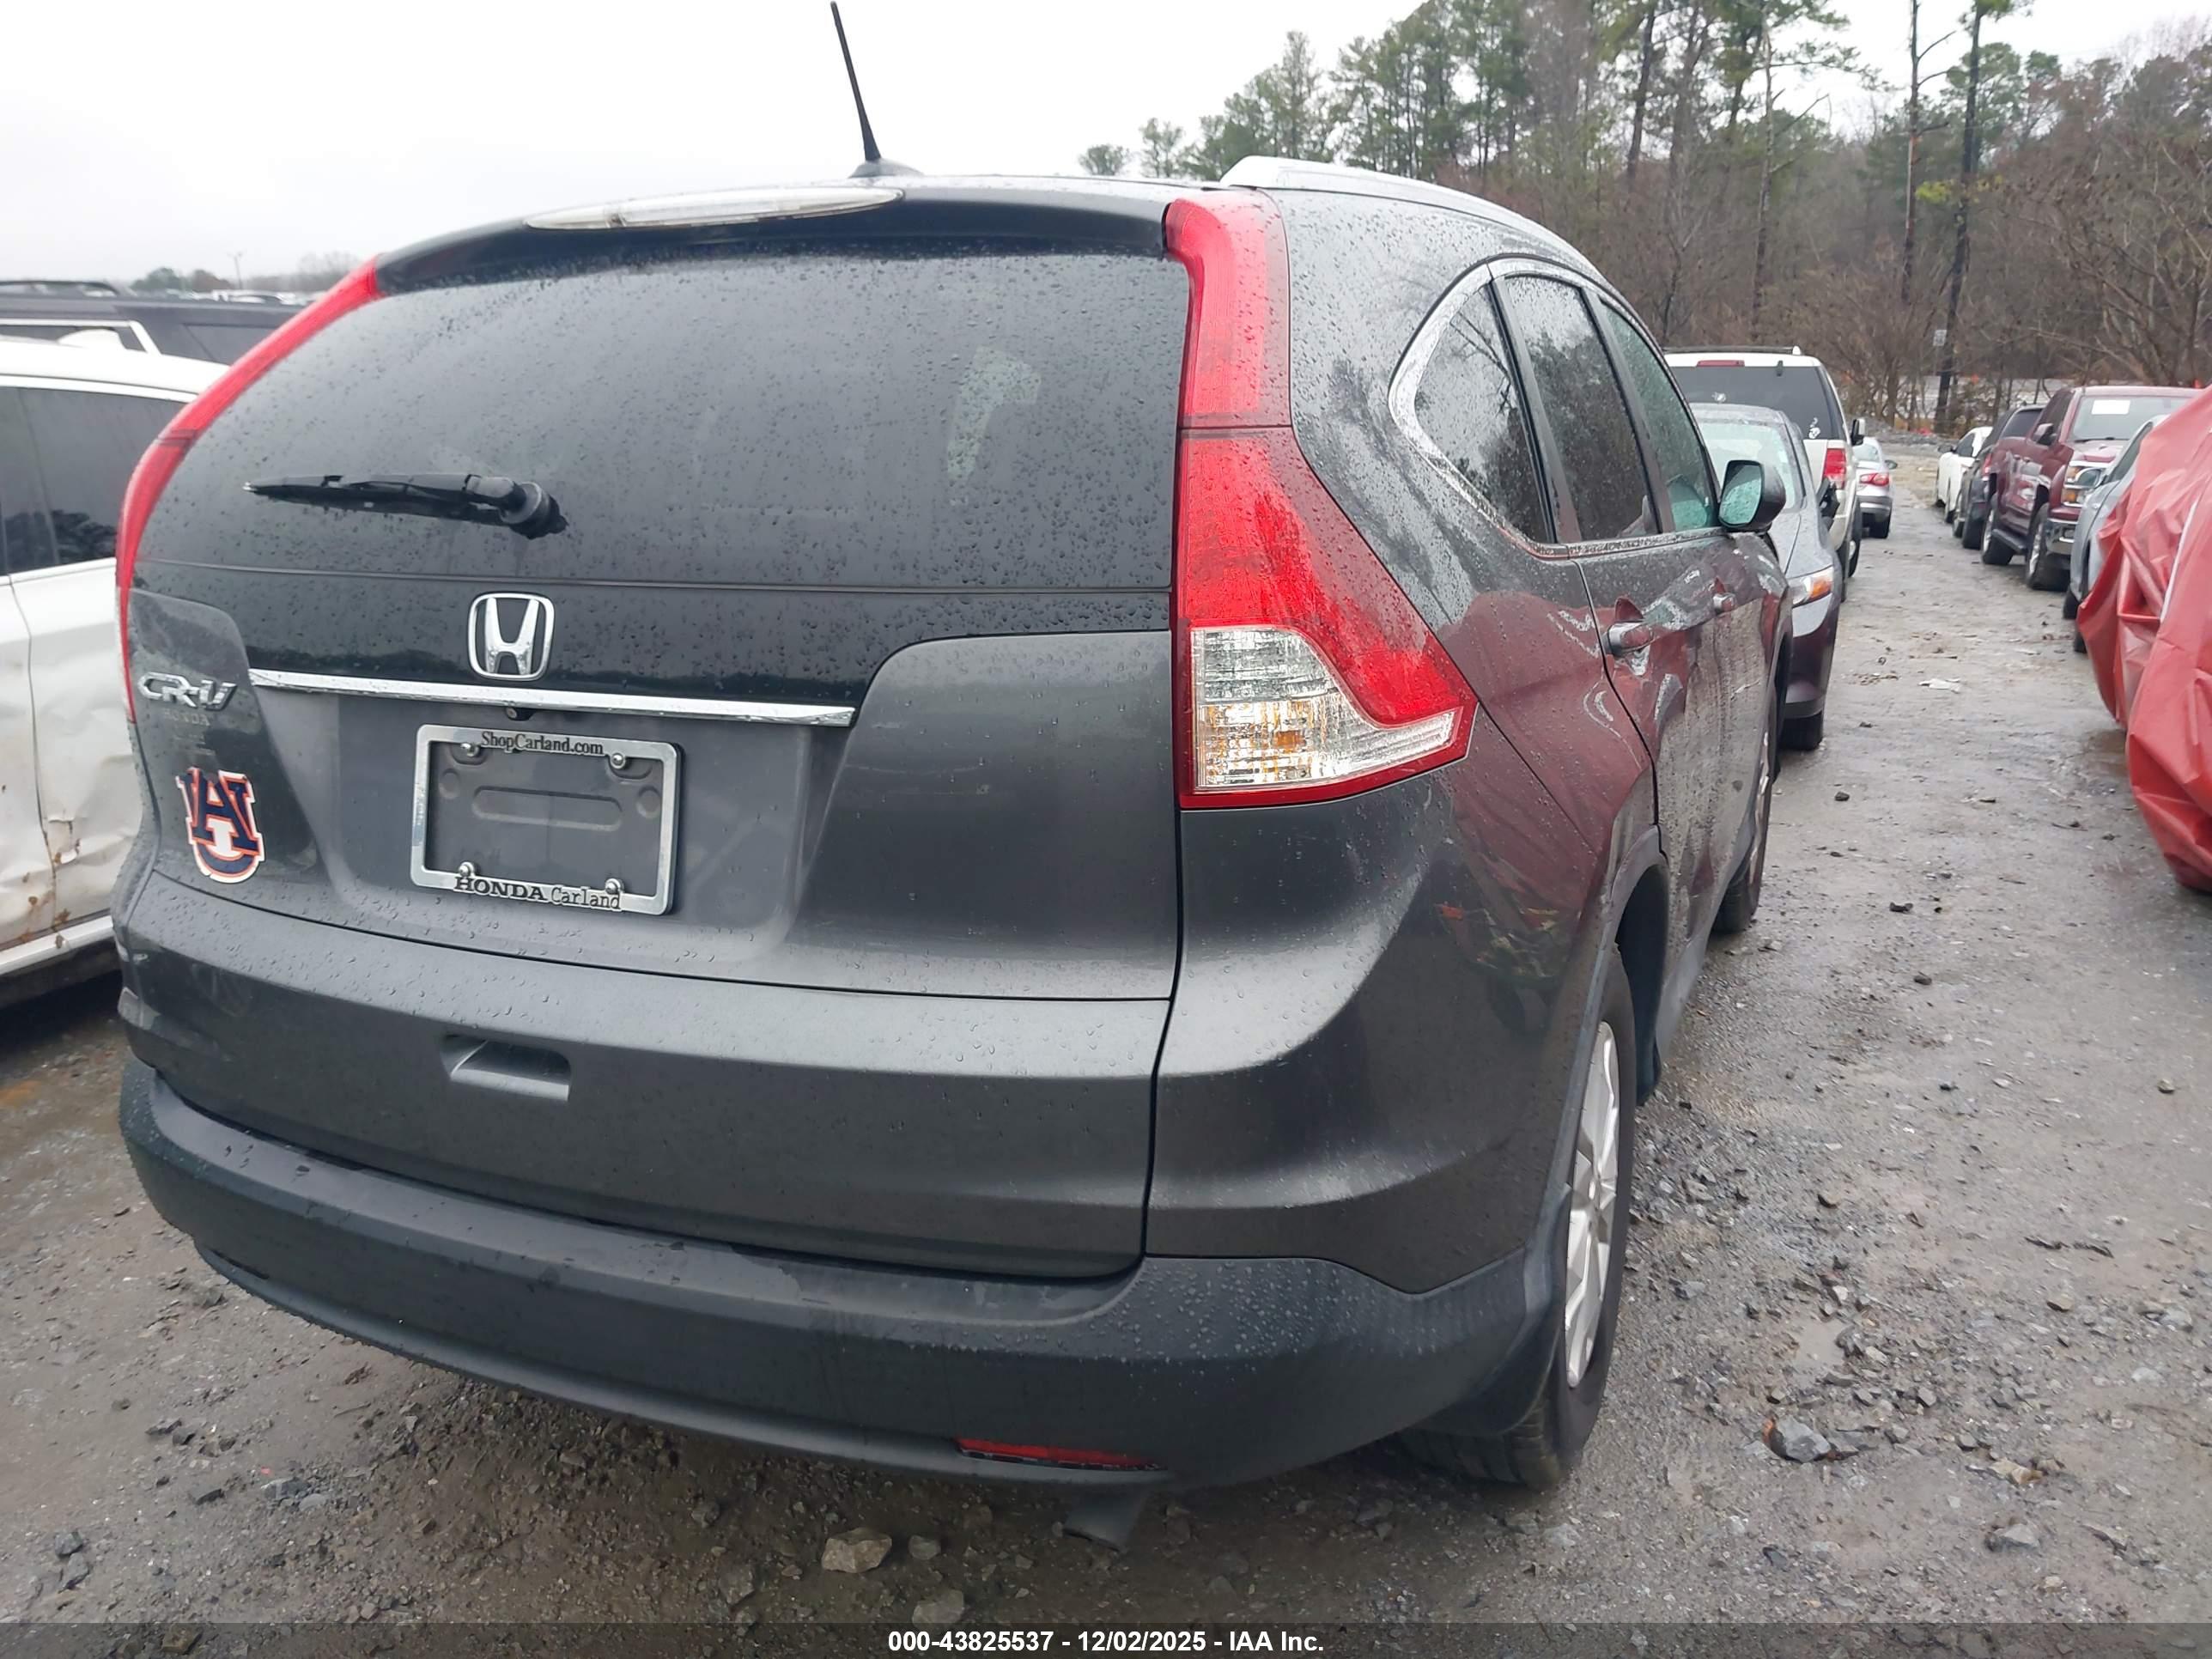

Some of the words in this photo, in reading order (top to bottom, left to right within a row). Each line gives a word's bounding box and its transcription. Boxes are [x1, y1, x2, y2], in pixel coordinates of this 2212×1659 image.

[480, 731, 605, 756] ShopCarland.com
[453, 877, 549, 901] HONDA
[550, 887, 622, 910] Carland
